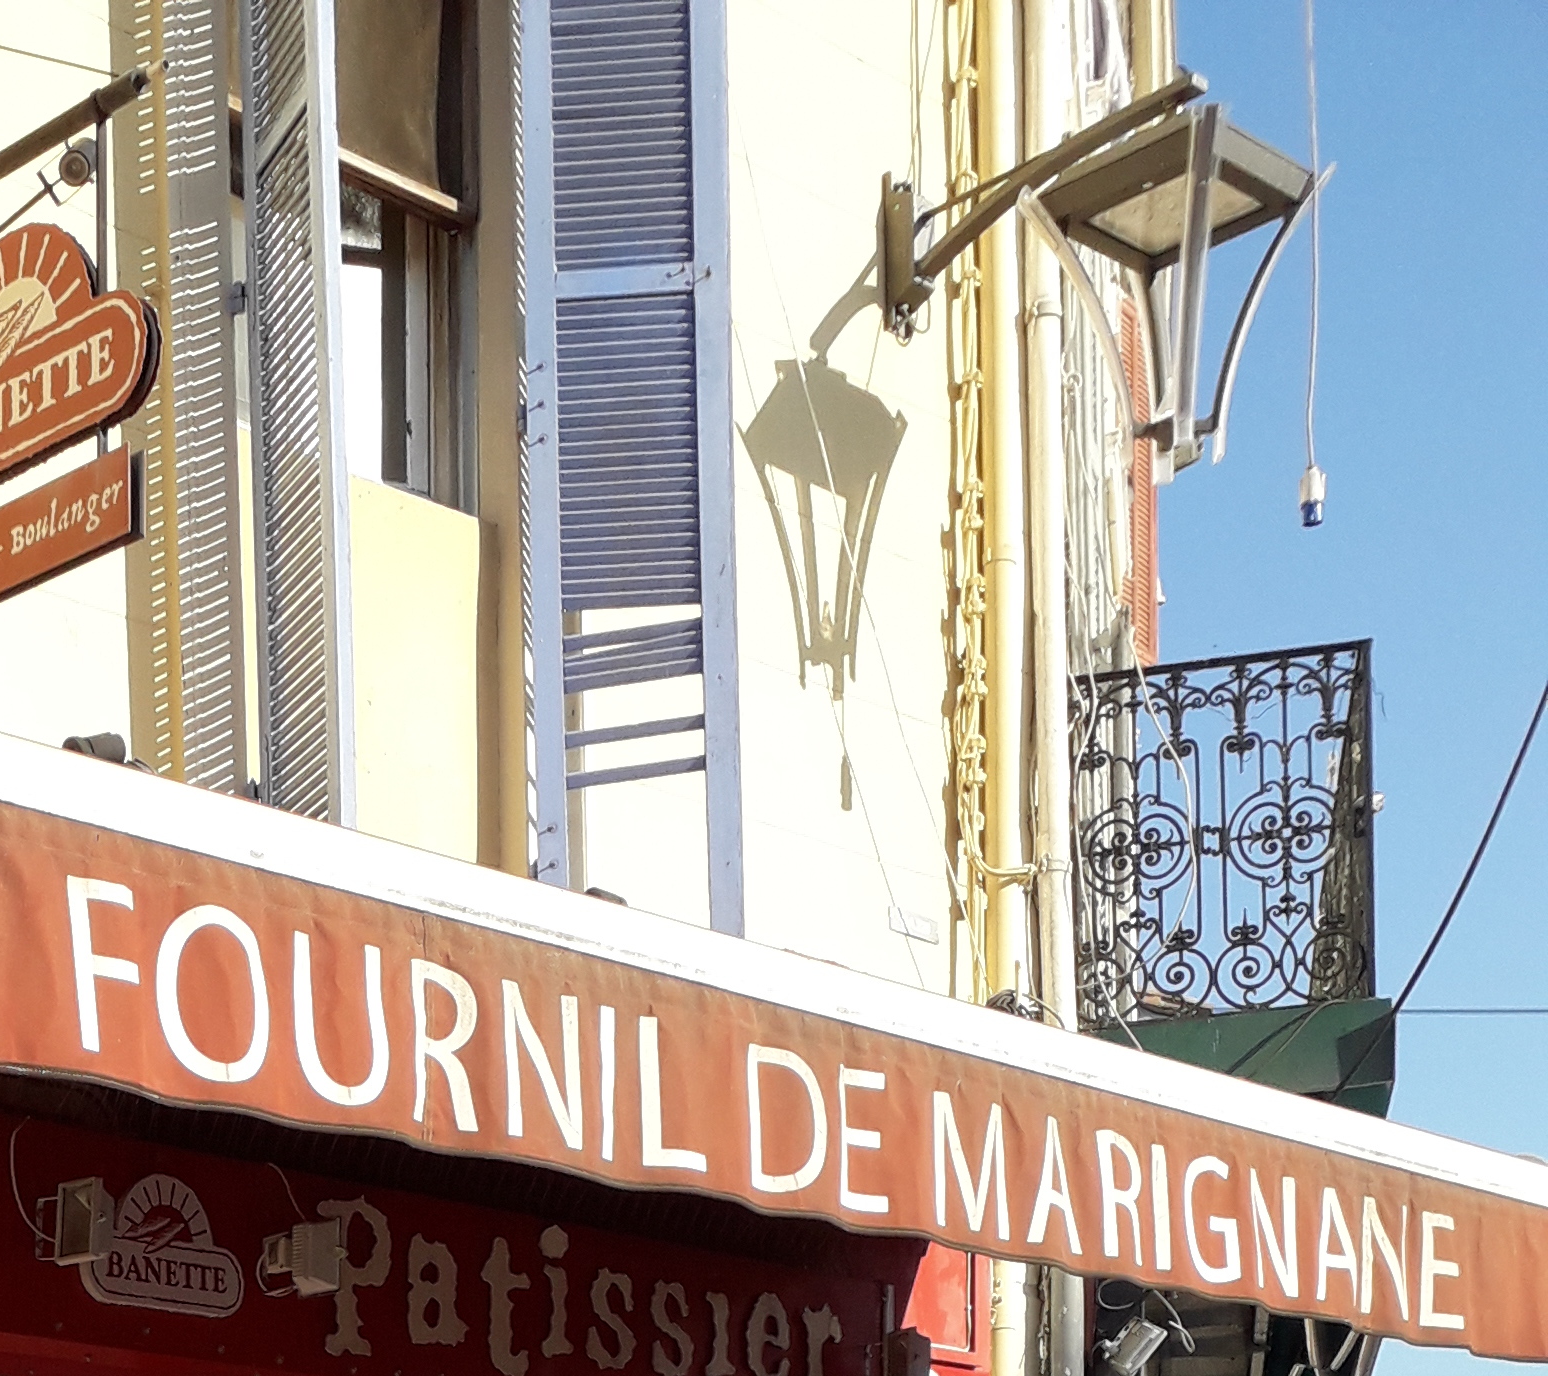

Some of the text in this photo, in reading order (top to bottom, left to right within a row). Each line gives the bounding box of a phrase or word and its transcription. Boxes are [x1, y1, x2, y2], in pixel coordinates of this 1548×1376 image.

[10, 479, 123, 555] Boulanger
[67, 875, 707, 1172] FOURNIL
[746, 1043, 889, 1215] DE
[932, 1091, 1464, 1330] MARIGNANE
[105, 1251, 228, 1294] BANETTE
